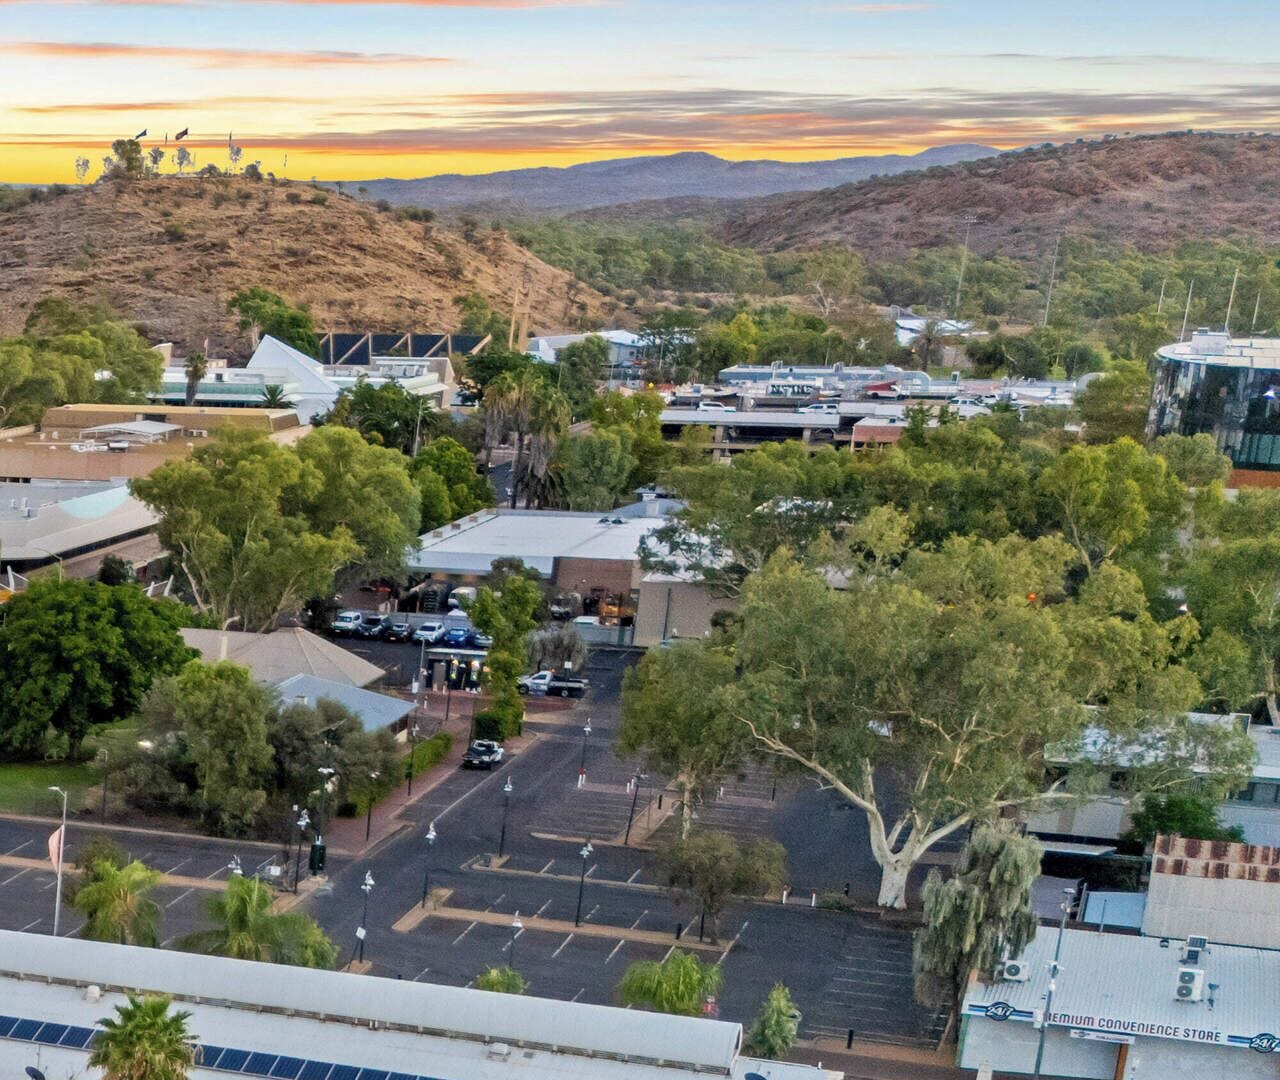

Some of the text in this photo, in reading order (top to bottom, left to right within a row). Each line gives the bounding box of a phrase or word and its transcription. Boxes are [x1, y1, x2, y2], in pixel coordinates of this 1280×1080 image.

[986, 1005, 1014, 1016] 24/7
[1098, 1017, 1180, 1037] CONVENIENCE
[1183, 1028, 1222, 1042] STORE
[1250, 1038, 1280, 1048] 24/7
